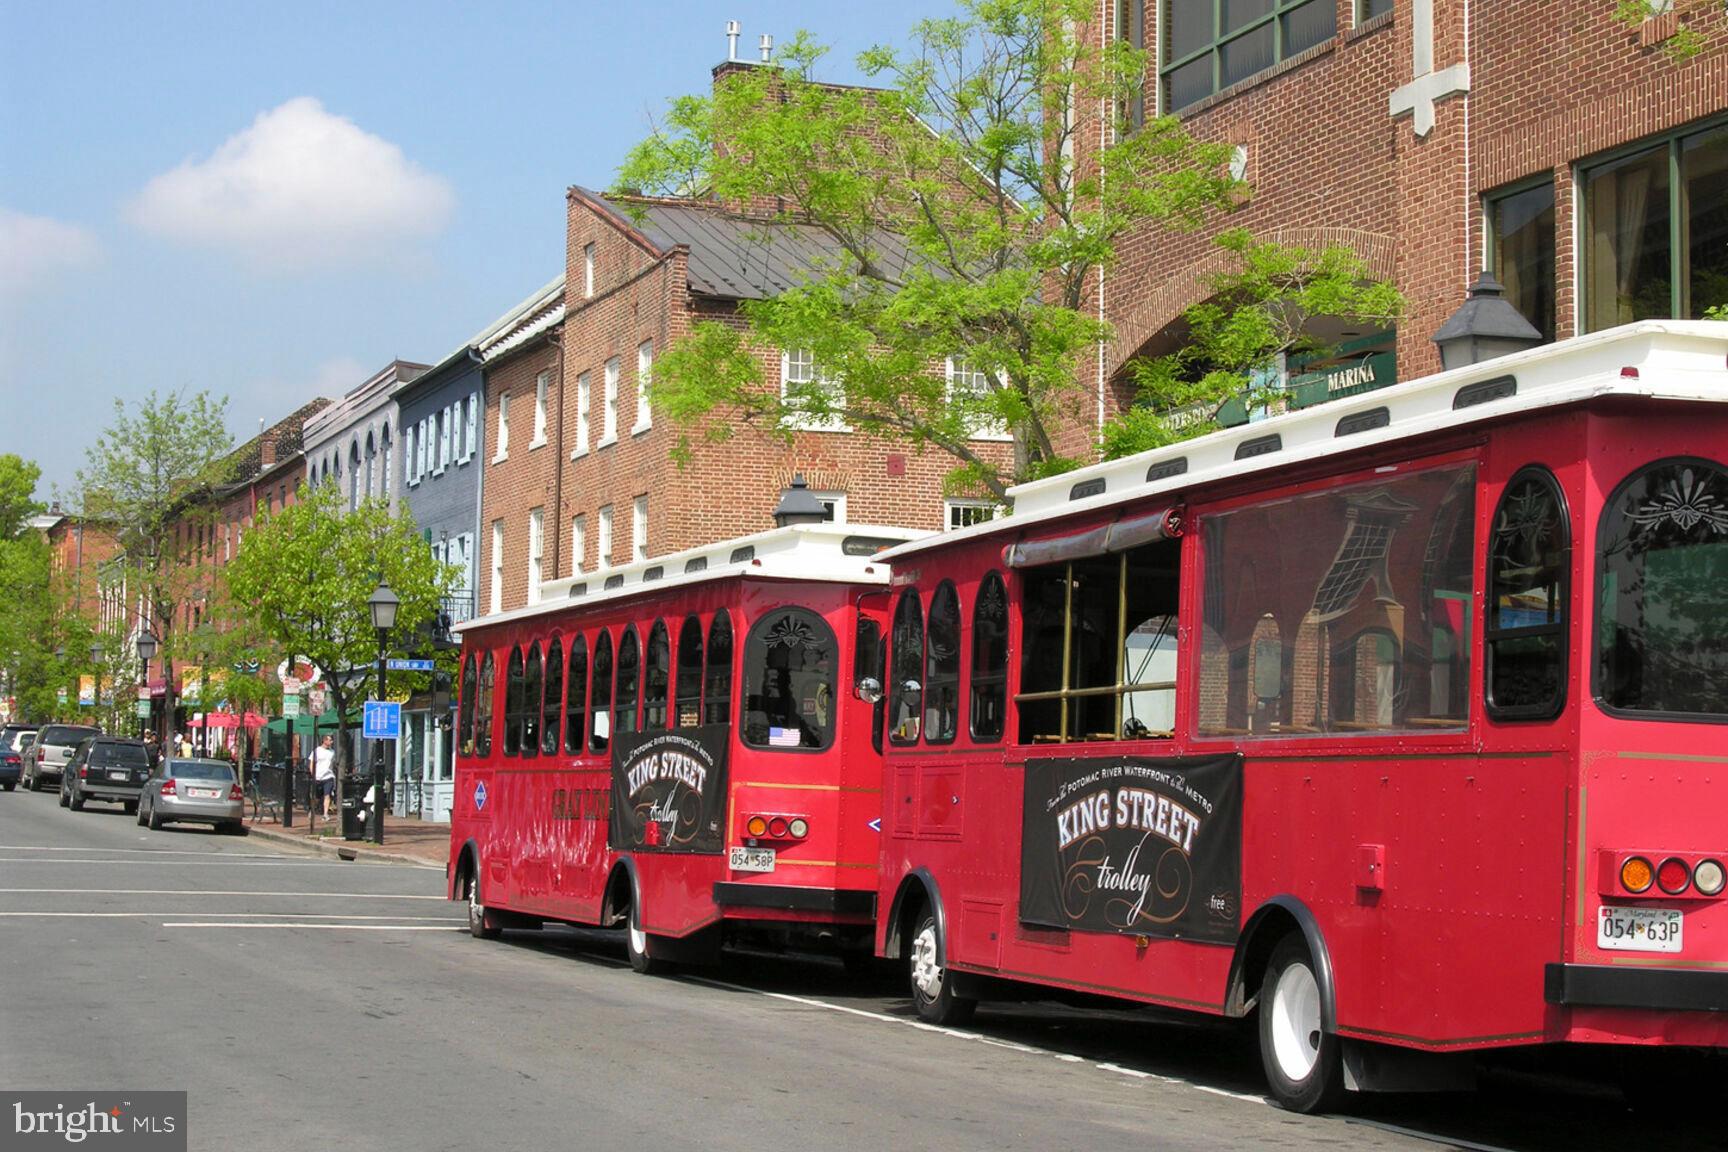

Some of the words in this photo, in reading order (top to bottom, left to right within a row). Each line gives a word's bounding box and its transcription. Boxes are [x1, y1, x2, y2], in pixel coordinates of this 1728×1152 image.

[1328, 364, 1375, 392] MARINA
[653, 736, 665, 745] RIVER
[666, 735, 692, 747] WATERFRONT
[628, 754, 659, 798] KING
[660, 752, 707, 795] STREET
[1067, 771, 1100, 794] POTOMAC
[1102, 766, 1123, 779] RIVER
[1124, 766, 1170, 784] WATERFRONT
[1185, 786, 1213, 814] METRO
[649, 779, 681, 847] trolley
[1057, 792, 1110, 848] KING
[1117, 788, 1200, 852] STREET
[731, 853, 749, 866] 054
[755, 855, 773, 867] 58P
[1097, 831, 1151, 927] trolley
[1210, 894, 1226, 911] free
[1603, 917, 1635, 939] 054
[1647, 920, 1679, 942] 63P
